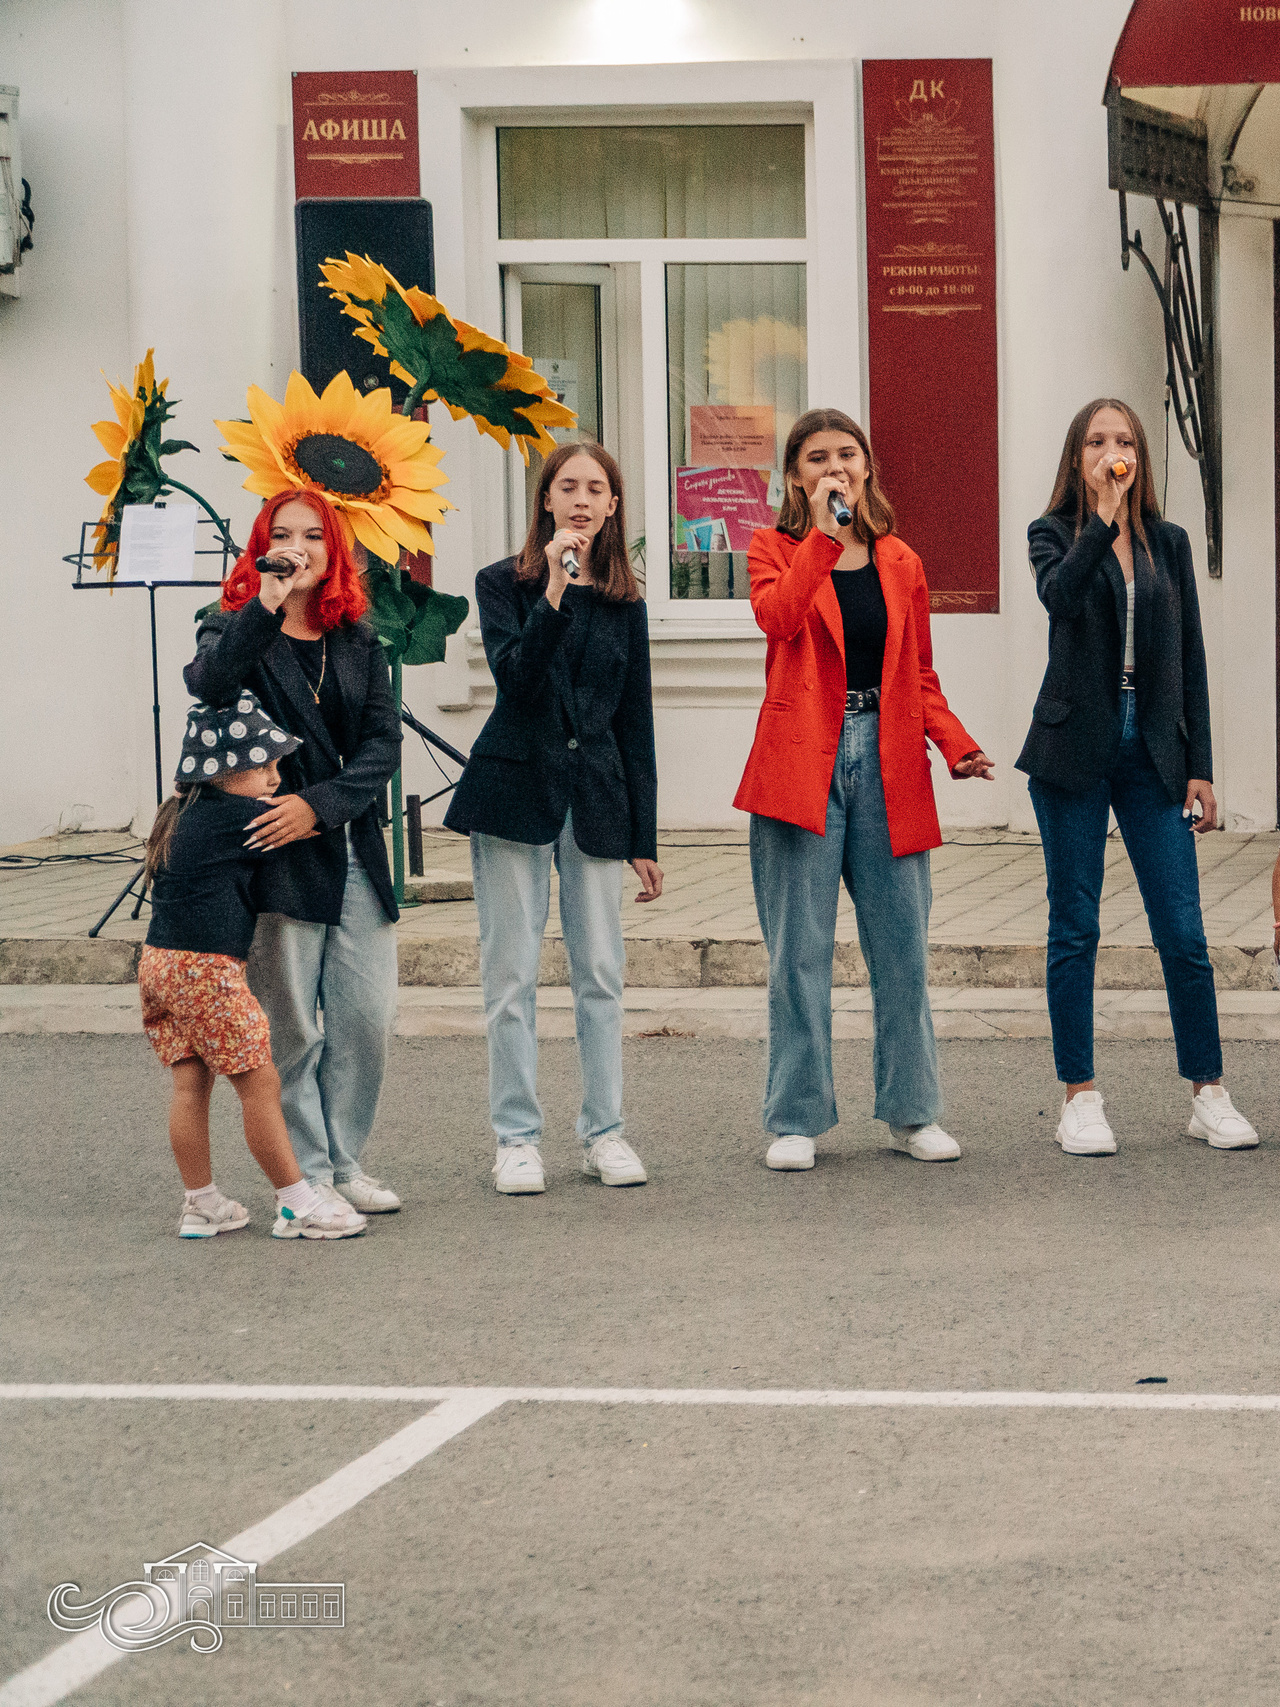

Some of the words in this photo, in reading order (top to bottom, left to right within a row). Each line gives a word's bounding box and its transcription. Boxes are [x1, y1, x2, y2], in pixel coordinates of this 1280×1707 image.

[909, 80, 945, 102] ДК
[302, 119, 406, 140] АФИША
[882, 265, 927, 276] РЕЖИМ
[889, 286, 896, 295] с
[925, 285, 940, 296] до
